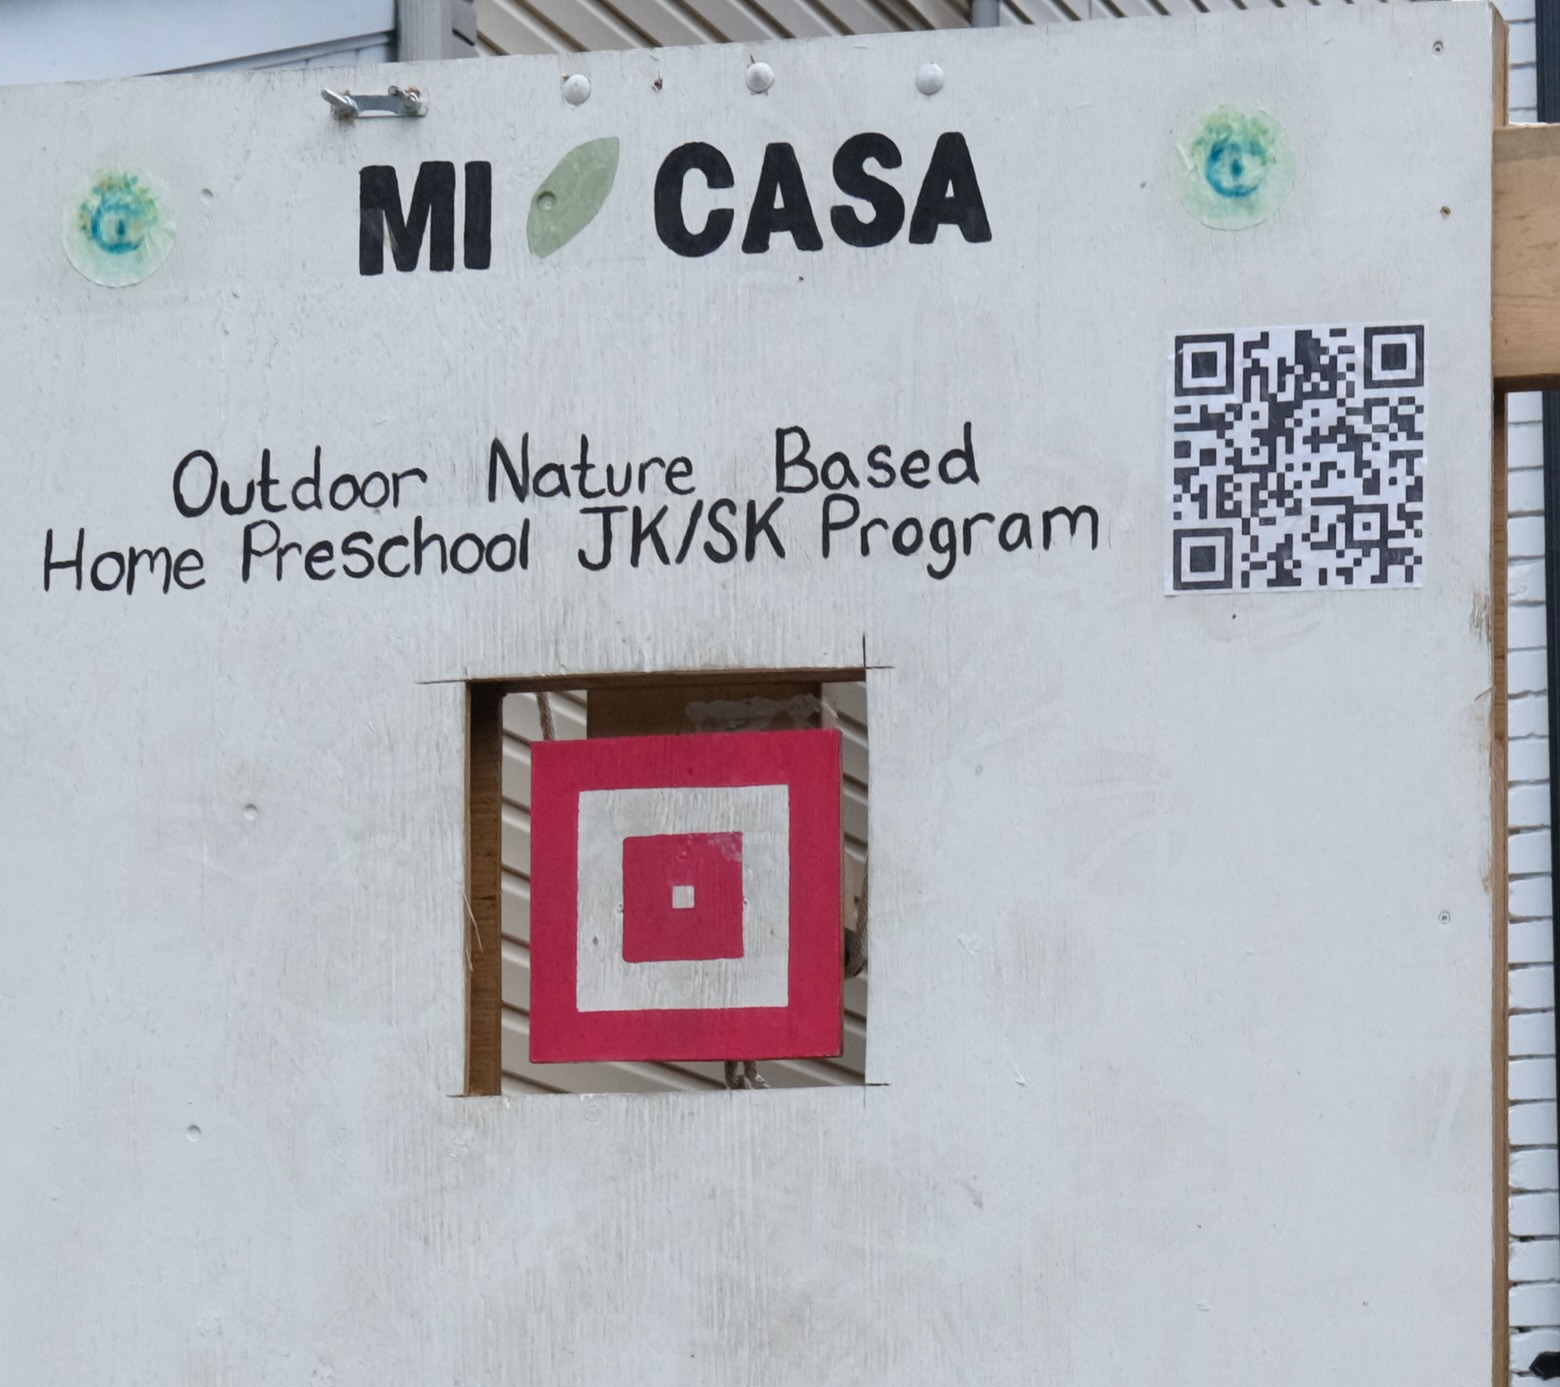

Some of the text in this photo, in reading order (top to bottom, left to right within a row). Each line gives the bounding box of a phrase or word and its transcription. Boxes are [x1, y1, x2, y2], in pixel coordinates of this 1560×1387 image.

[358, 131, 993, 276] MI CASA
[172, 420, 980, 518] Outdoor Nature Based
[43, 493, 1099, 596] Home Preschool JK/SK Program
